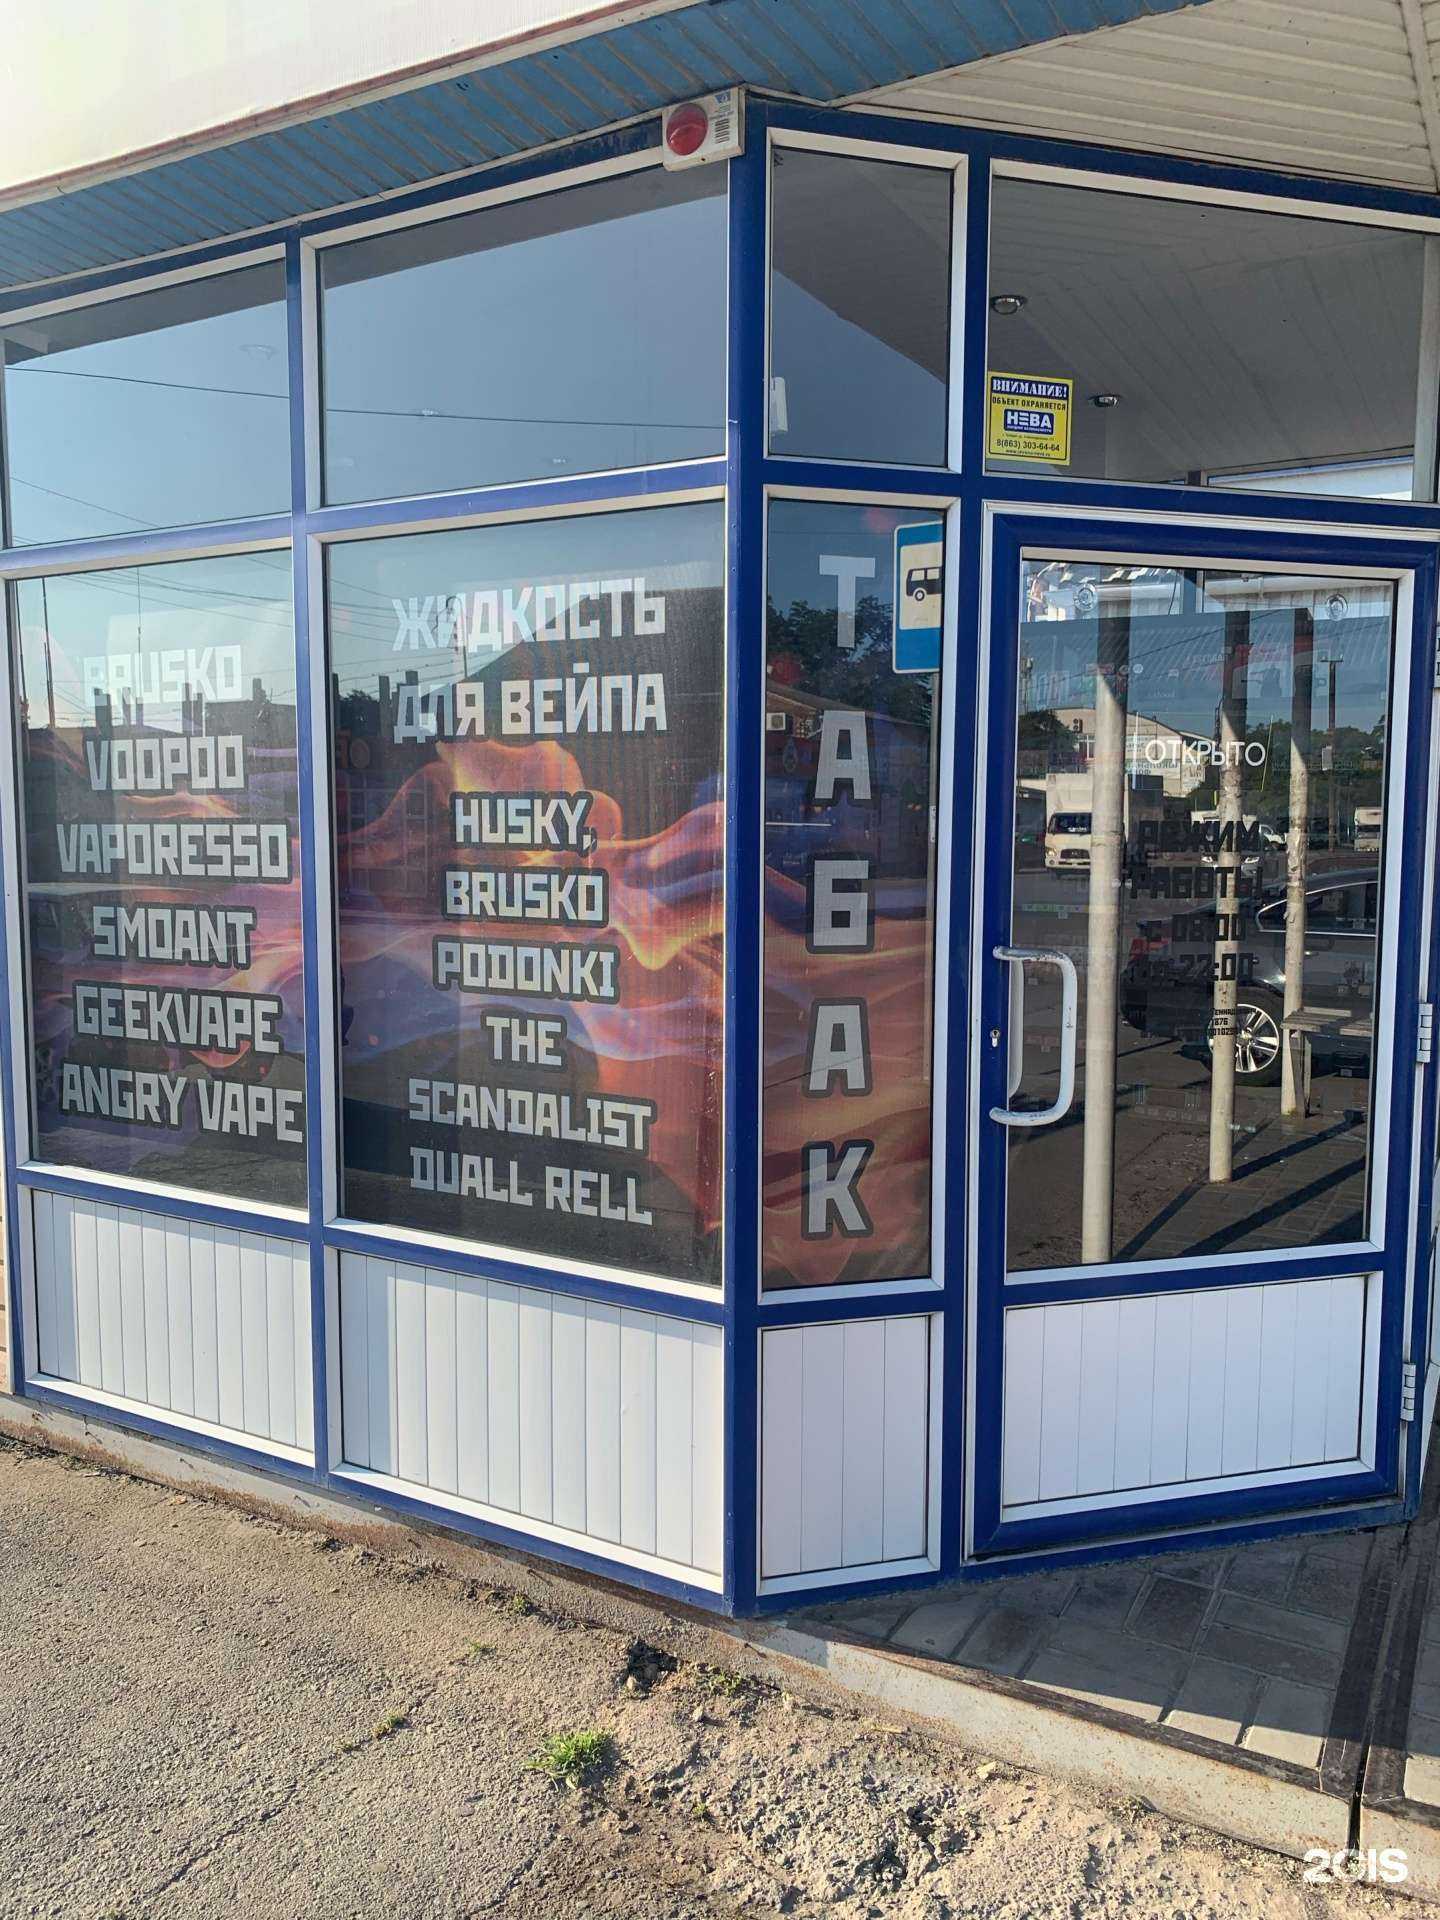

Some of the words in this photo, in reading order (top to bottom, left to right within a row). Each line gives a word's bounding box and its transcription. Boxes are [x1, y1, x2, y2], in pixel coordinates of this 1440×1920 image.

[992, 379, 1067, 398] ВНИМАНИЕ!
[992, 396, 1019, 406] ОБЪЕКТ
[1021, 399, 1066, 411] ОХРАНЯЕТСЯ
[996, 439, 1020, 449] 8(863)
[1022, 441, 1060, 452] 303-64-64
[391, 577, 666, 653] ЖИДКОСТЬ
[393, 682, 485, 744] ДЛЯ
[501, 662, 667, 735] ВЕЙПА
[86, 736, 243, 790] VOOPOO
[1145, 739, 1266, 767] ОТКРЫТО
[56, 824, 287, 879] VAPORESSO
[1138, 820, 1260, 854] РЕЖИМ
[445, 871, 603, 921] BRUSKO
[1130, 865, 1263, 899] РАБОТЫ
[92, 906, 254, 964] SMOANT
[437, 942, 615, 998] PODONKI
[75, 985, 281, 1054] GEEKVAPE
[486, 1016, 562, 1066] THE
[62, 1065, 187, 1126] ANGRY
[197, 1080, 303, 1143] VAPE
[408, 1078, 651, 1150] SCANDALIST
[410, 1147, 533, 1207] DUALL
[545, 1166, 653, 1226] RELL
